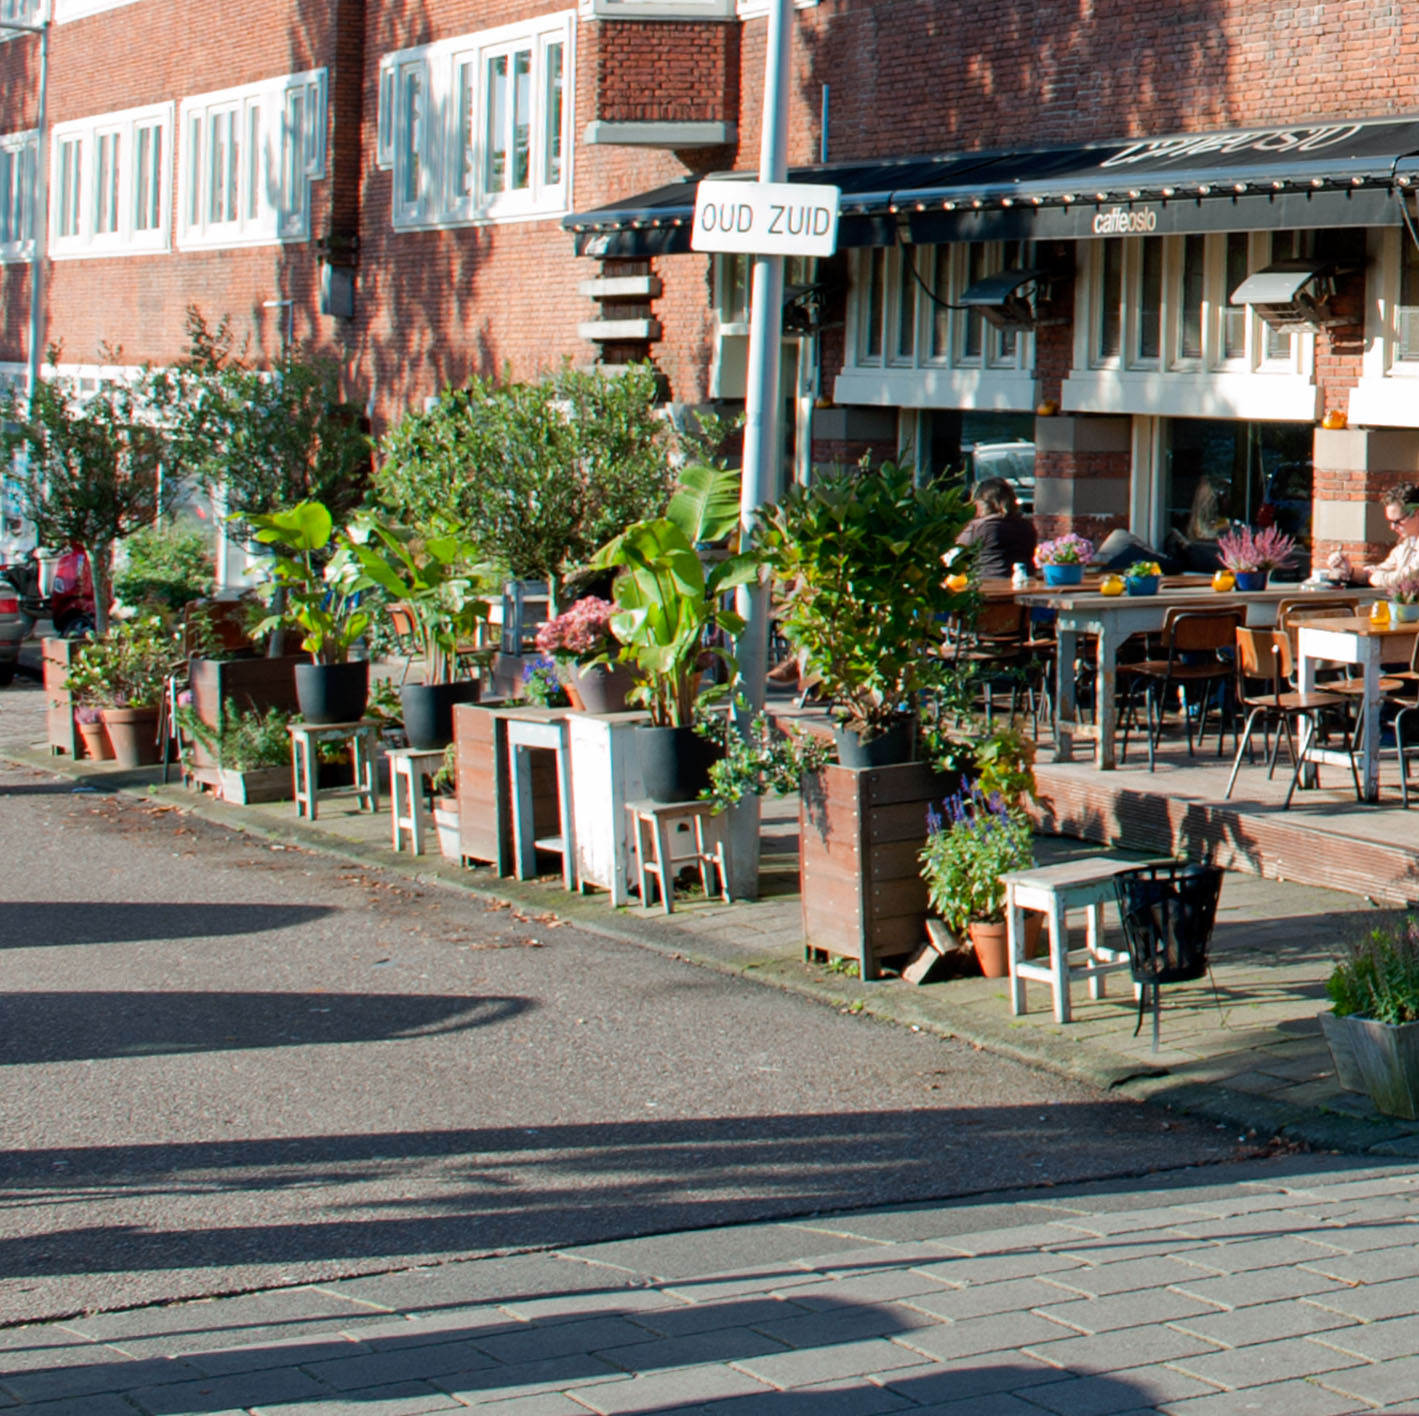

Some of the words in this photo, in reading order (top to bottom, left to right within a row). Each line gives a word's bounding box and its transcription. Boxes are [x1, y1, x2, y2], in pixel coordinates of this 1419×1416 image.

[701, 202, 754, 233] OUD
[767, 204, 832, 237] ZUID
[1092, 205, 1157, 234] caffeoslo
